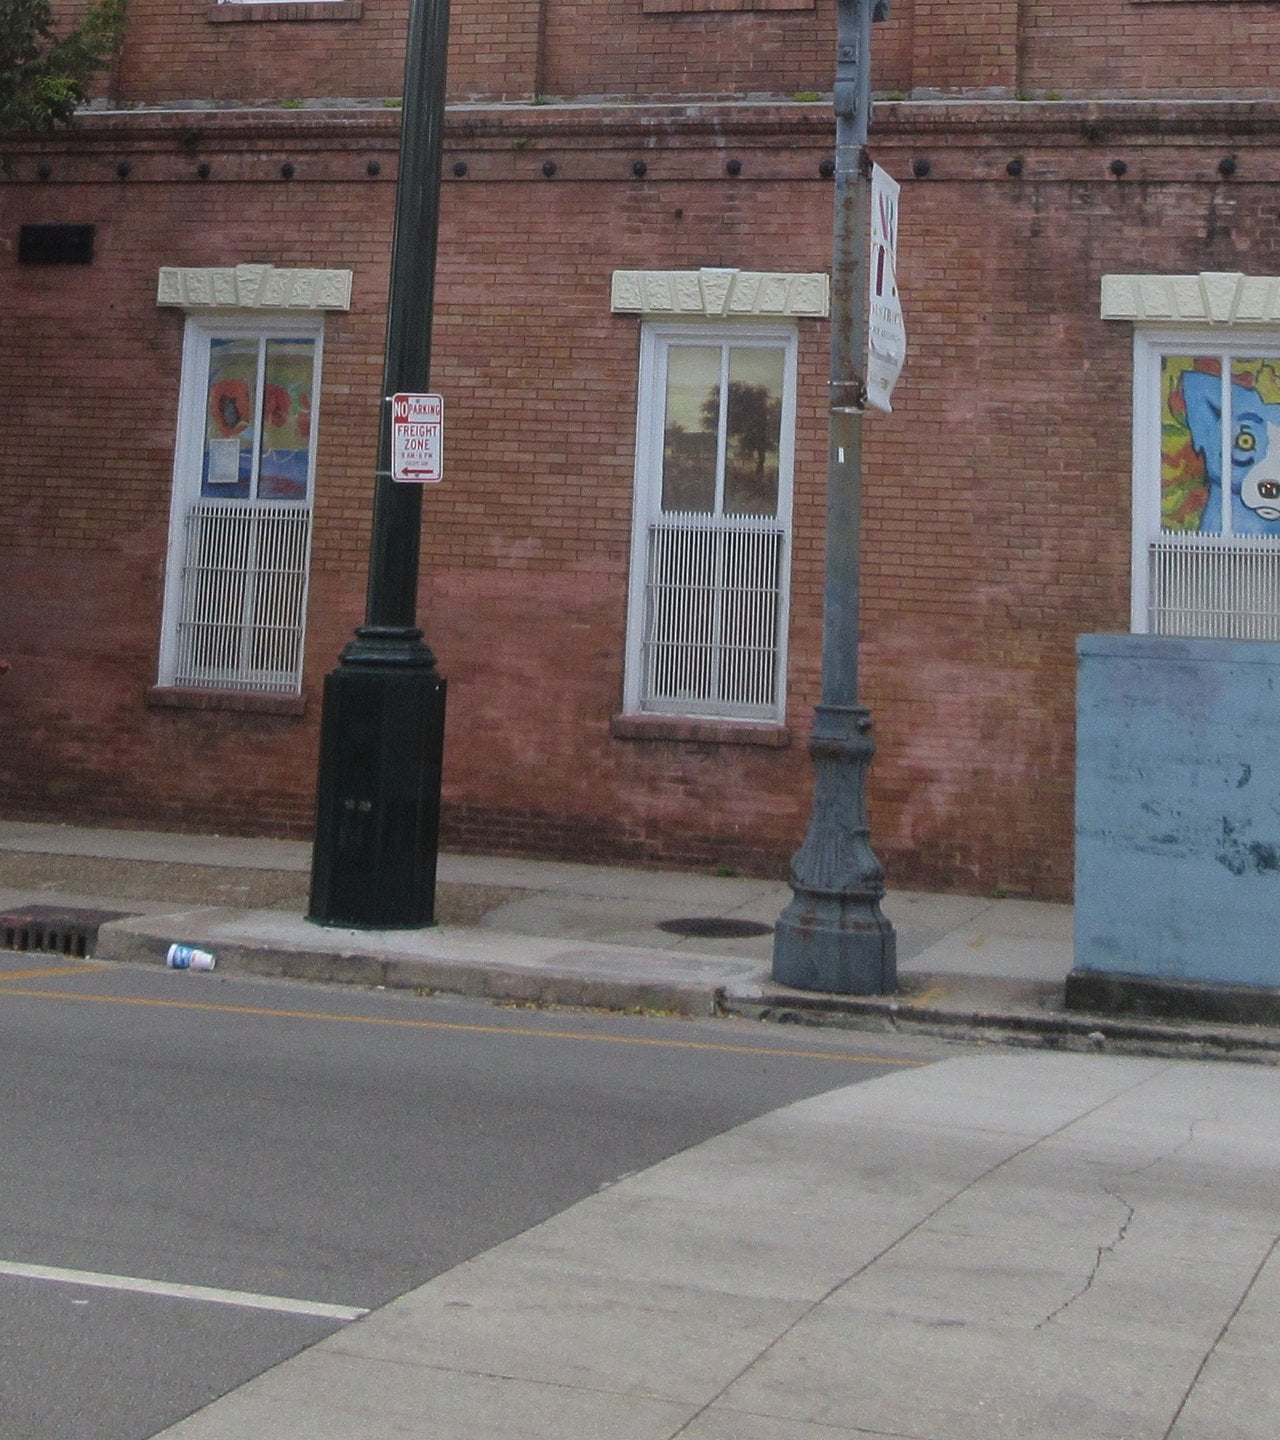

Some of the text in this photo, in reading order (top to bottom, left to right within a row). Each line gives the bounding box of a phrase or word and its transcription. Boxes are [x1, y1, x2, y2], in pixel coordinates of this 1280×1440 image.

[394, 401, 441, 417] NO PARKING
[397, 425, 438, 437] FREIGHT
[404, 438, 430, 451] ZONE
